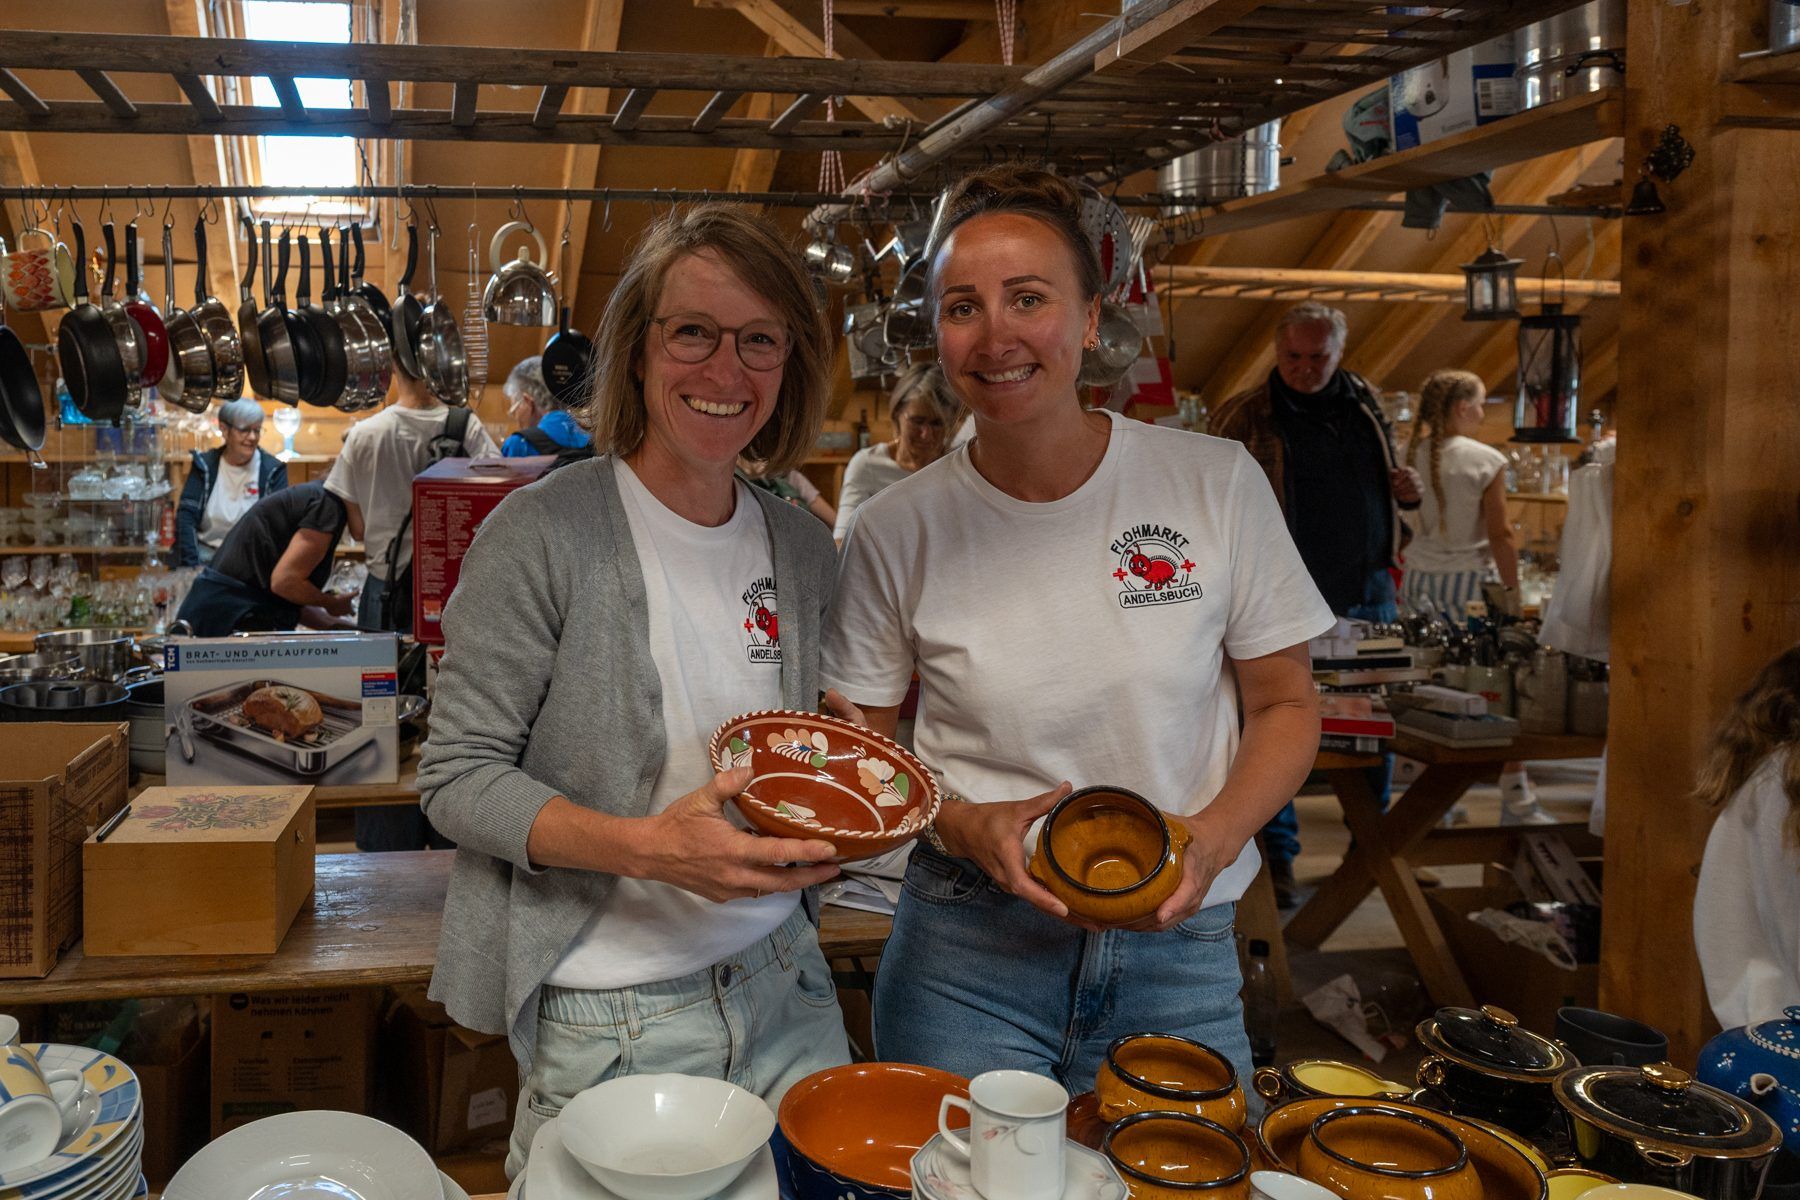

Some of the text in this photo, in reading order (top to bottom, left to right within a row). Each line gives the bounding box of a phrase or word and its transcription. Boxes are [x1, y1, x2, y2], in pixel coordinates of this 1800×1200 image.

[1110, 524, 1190, 555] FLOHMARKT
[1124, 586, 1200, 605] ANDELSBUCH
[167, 647, 175, 669] TCM
[186, 648, 338, 659] BRAT- UND AUFLAUFFORM
